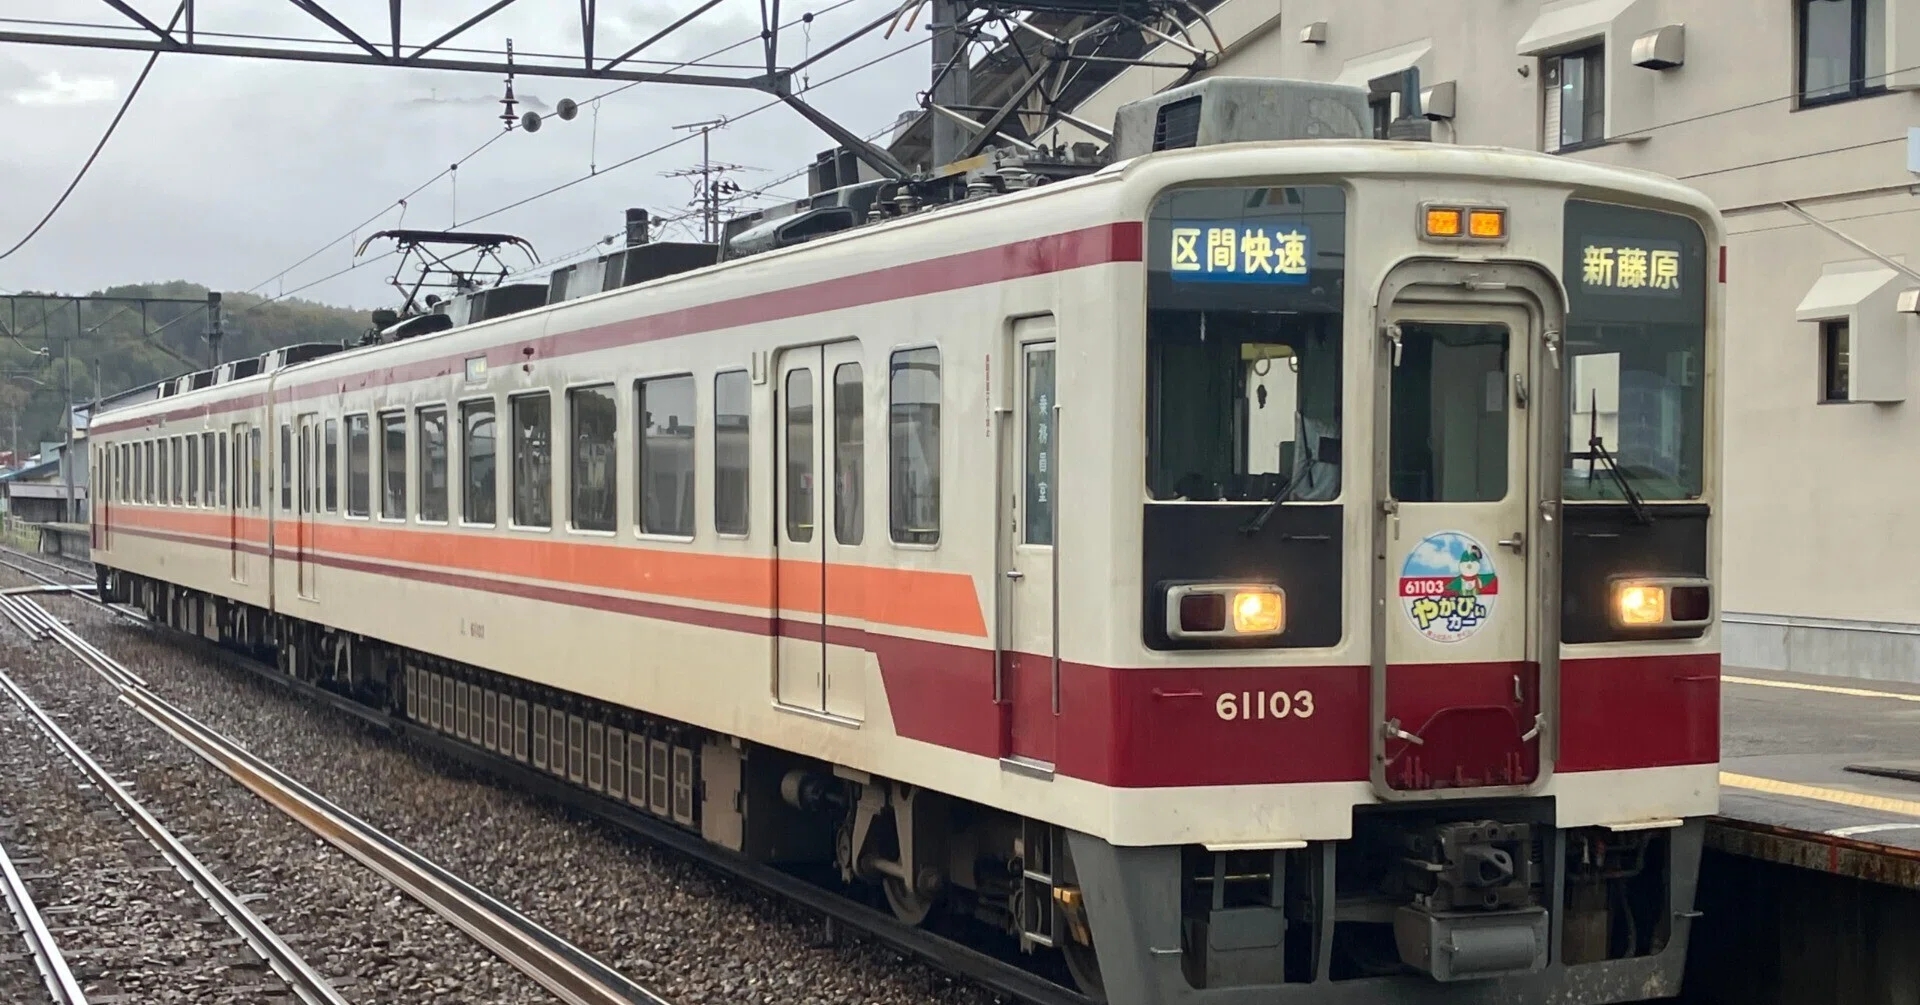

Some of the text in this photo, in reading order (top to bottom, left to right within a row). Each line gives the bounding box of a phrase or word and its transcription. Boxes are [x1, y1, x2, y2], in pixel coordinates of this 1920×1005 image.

[1172, 228, 1307, 274] 区間快速
[1583, 245, 1679, 289] 新藤原
[1405, 580, 1444, 594] 61103
[1447, 613, 1476, 632] カー
[1216, 690, 1314, 720] 61103
